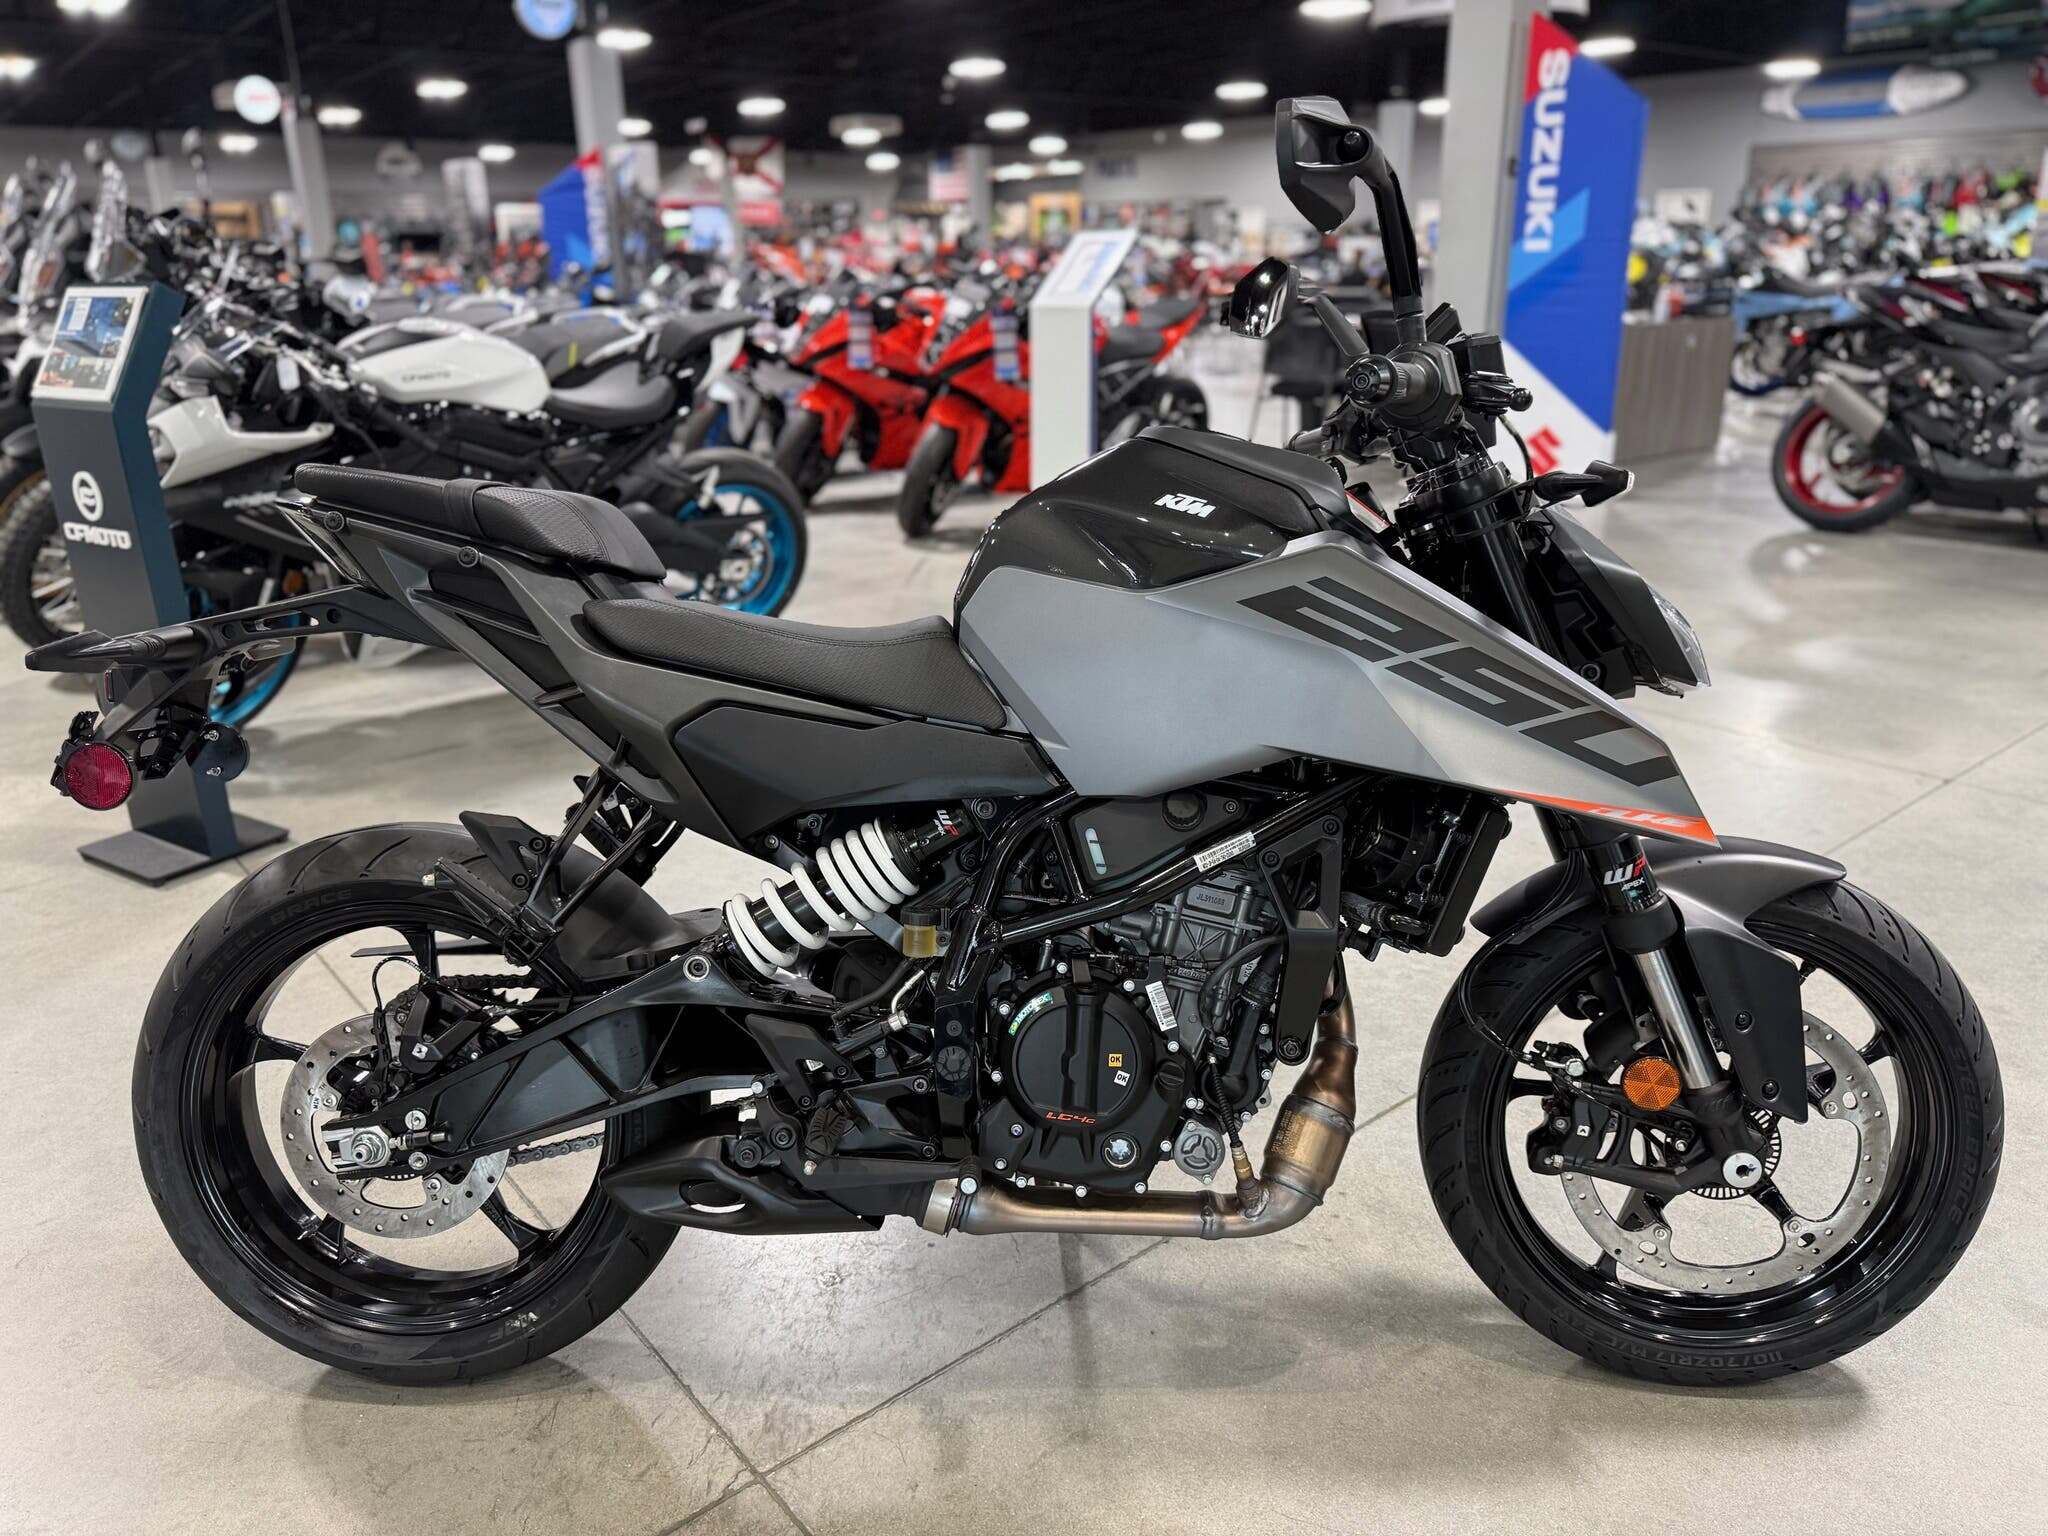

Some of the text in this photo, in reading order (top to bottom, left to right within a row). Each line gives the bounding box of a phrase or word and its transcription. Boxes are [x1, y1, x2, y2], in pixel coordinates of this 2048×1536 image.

[1523, 48, 1571, 252] SUZUKI
[1154, 493, 1216, 518] KTM
[63, 522, 132, 550] CFMOTO
[1236, 576, 1680, 787] 250
[936, 809, 960, 837] WP
[1603, 855, 1646, 886] WP
[271, 888, 352, 926] BRACE
[1110, 1056, 1121, 1064] OK
[1116, 1072, 1128, 1083] OK
[1948, 1137, 1981, 1225] BRACE
[1655, 1350, 1783, 1369] 110/70ZR17
